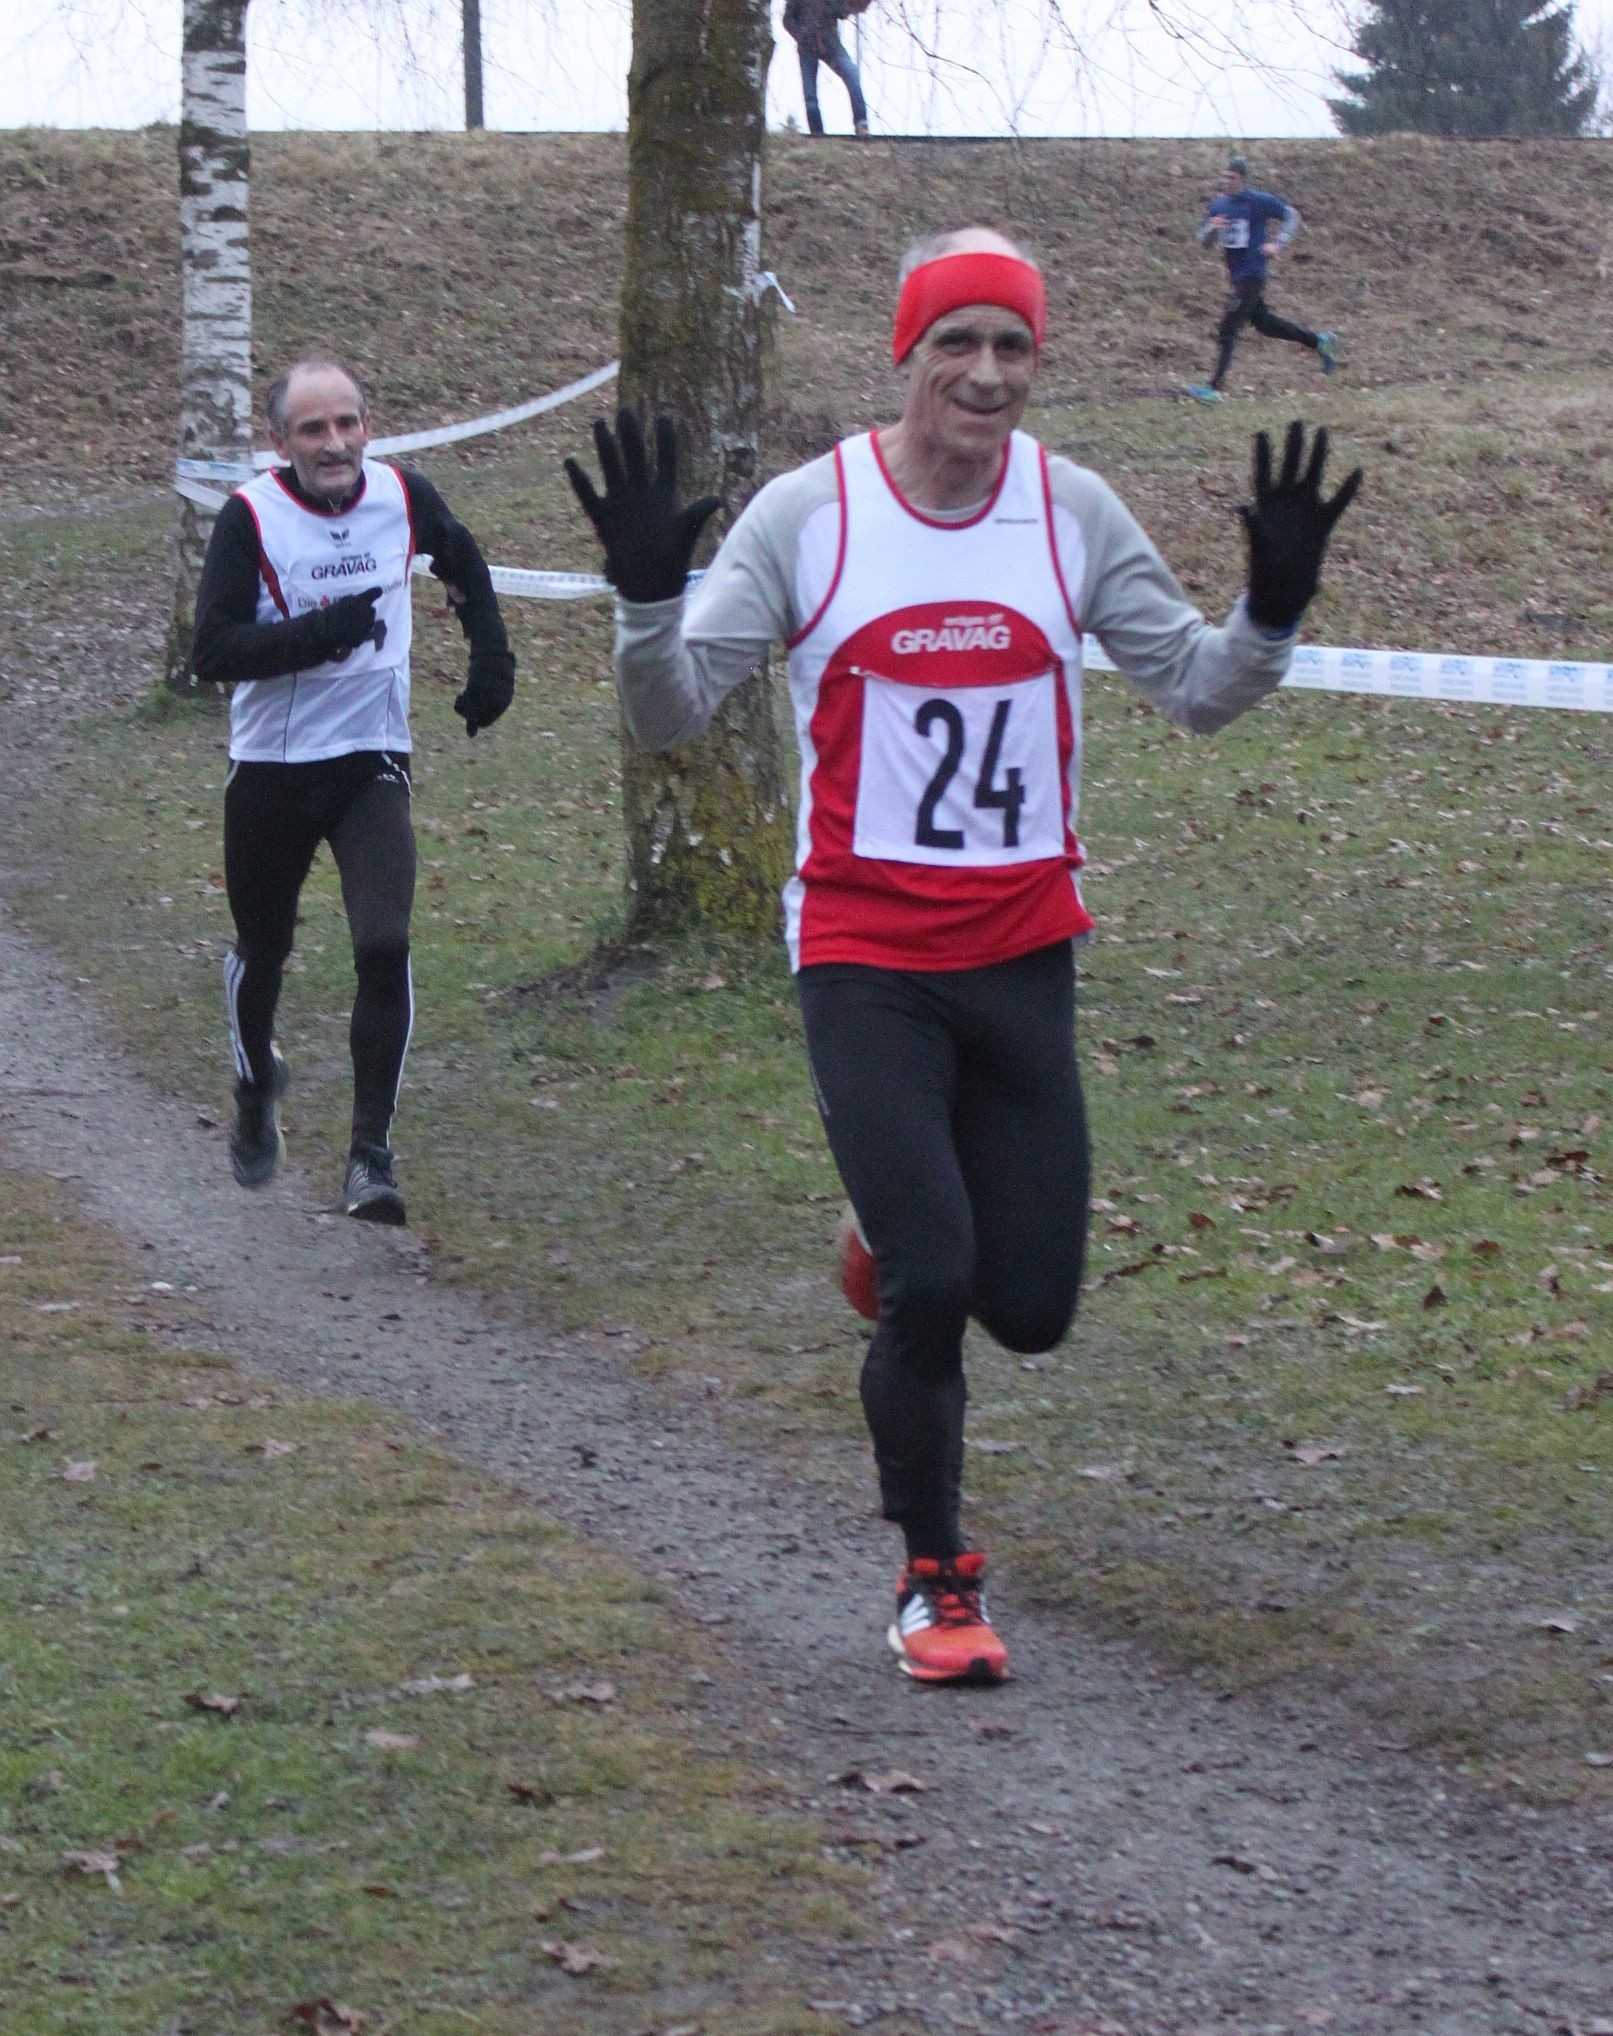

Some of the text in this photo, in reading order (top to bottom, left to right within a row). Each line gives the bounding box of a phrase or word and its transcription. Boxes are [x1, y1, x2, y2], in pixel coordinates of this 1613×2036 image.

[311, 559, 377, 580] GRAVAG
[891, 625, 1011, 654] GRAVAG
[915, 698, 1025, 849] 24
